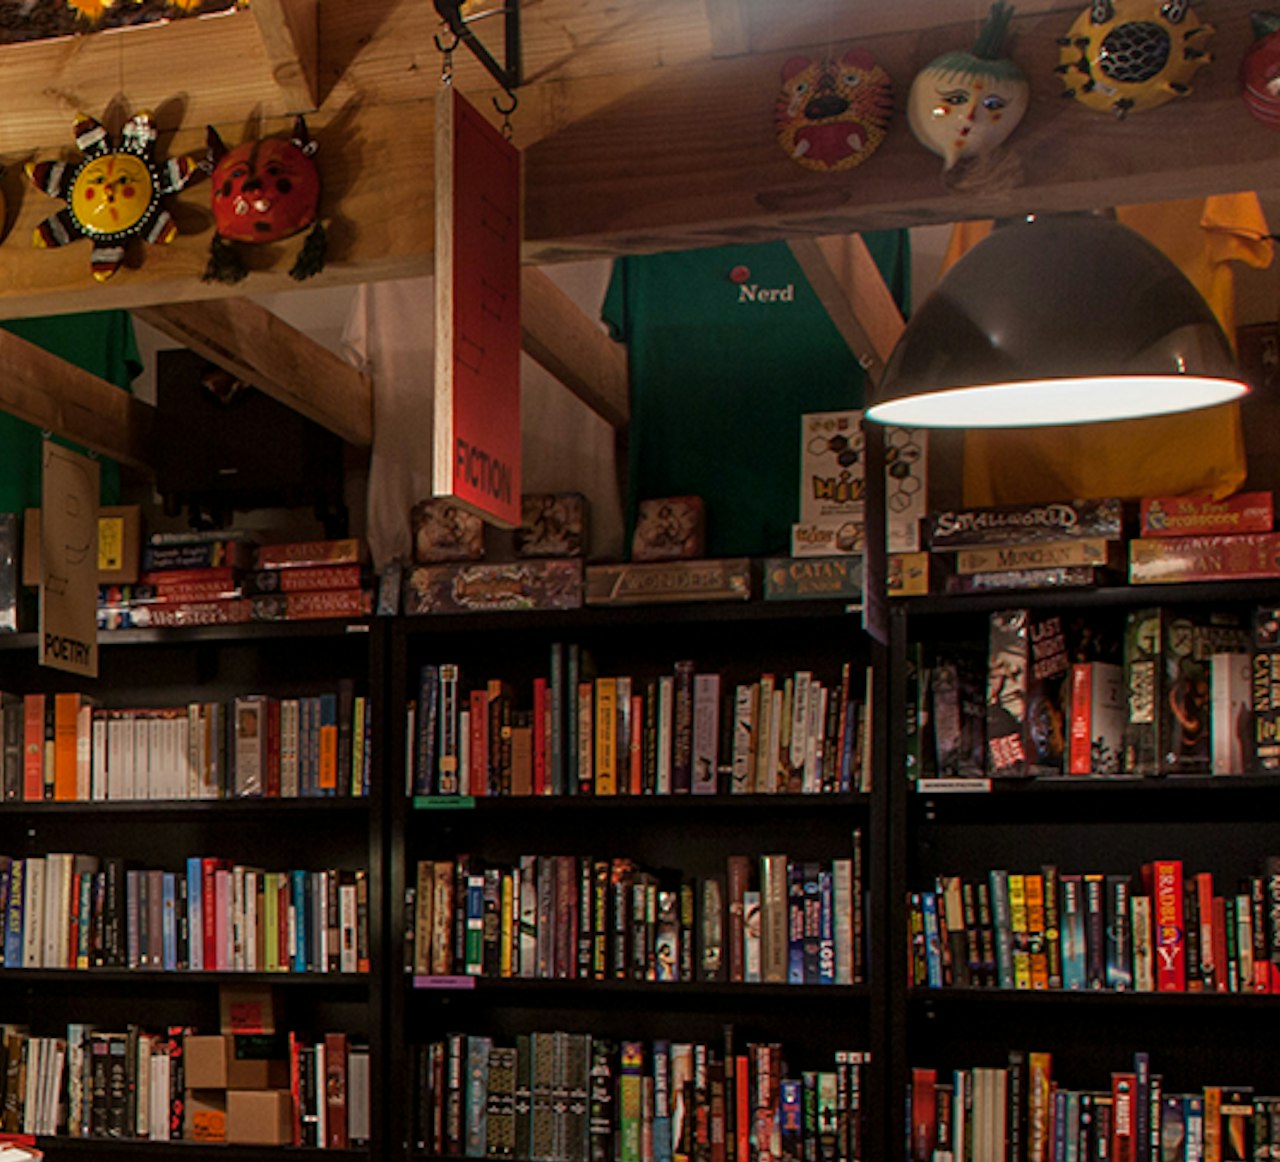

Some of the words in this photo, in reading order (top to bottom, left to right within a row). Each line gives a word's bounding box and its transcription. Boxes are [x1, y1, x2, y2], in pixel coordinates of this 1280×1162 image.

[739, 284, 794, 303] Nerd
[455, 437, 513, 504] FICTION
[626, 571, 725, 590] WONDERS
[790, 562, 848, 579] CATAN
[285, 576, 358, 591] THESAURUS
[44, 633, 91, 666] POETRY
[9, 860, 22, 906] INFINITE
[10, 908, 21, 933] JEST
[820, 940, 835, 979] LOST
